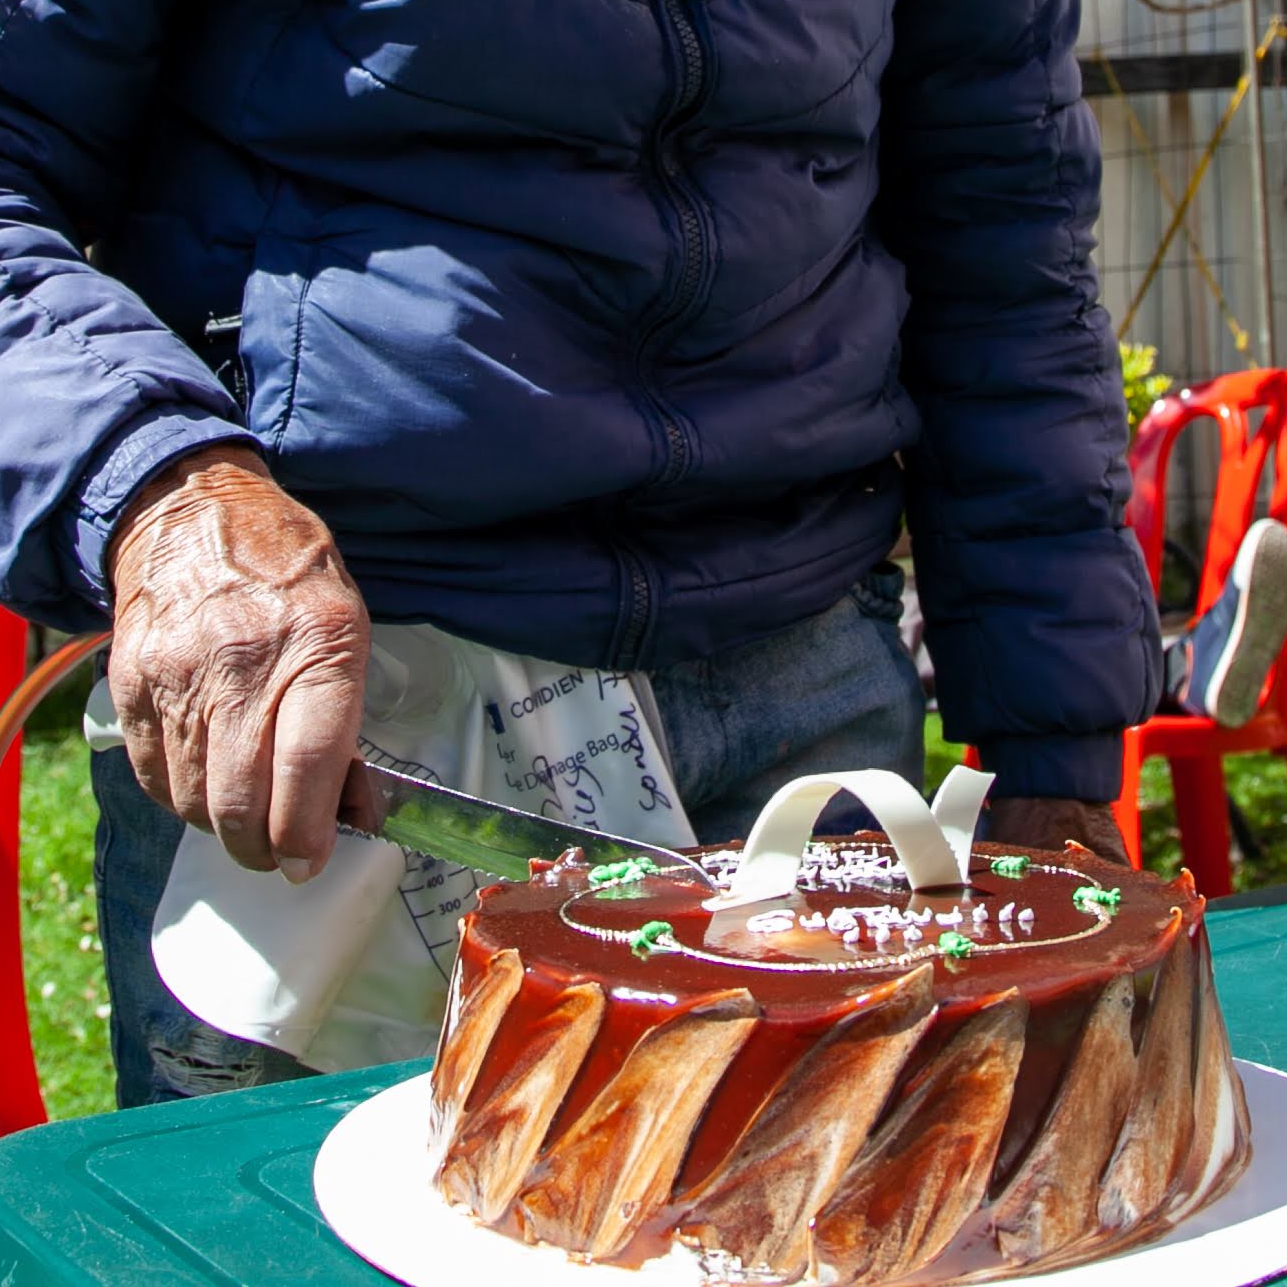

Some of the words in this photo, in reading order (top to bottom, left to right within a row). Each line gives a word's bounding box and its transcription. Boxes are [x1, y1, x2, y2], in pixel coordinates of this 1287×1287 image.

[586, 733, 620, 759] Bag
[426, 874, 445, 890] 400
[438, 898, 462, 915] 300
